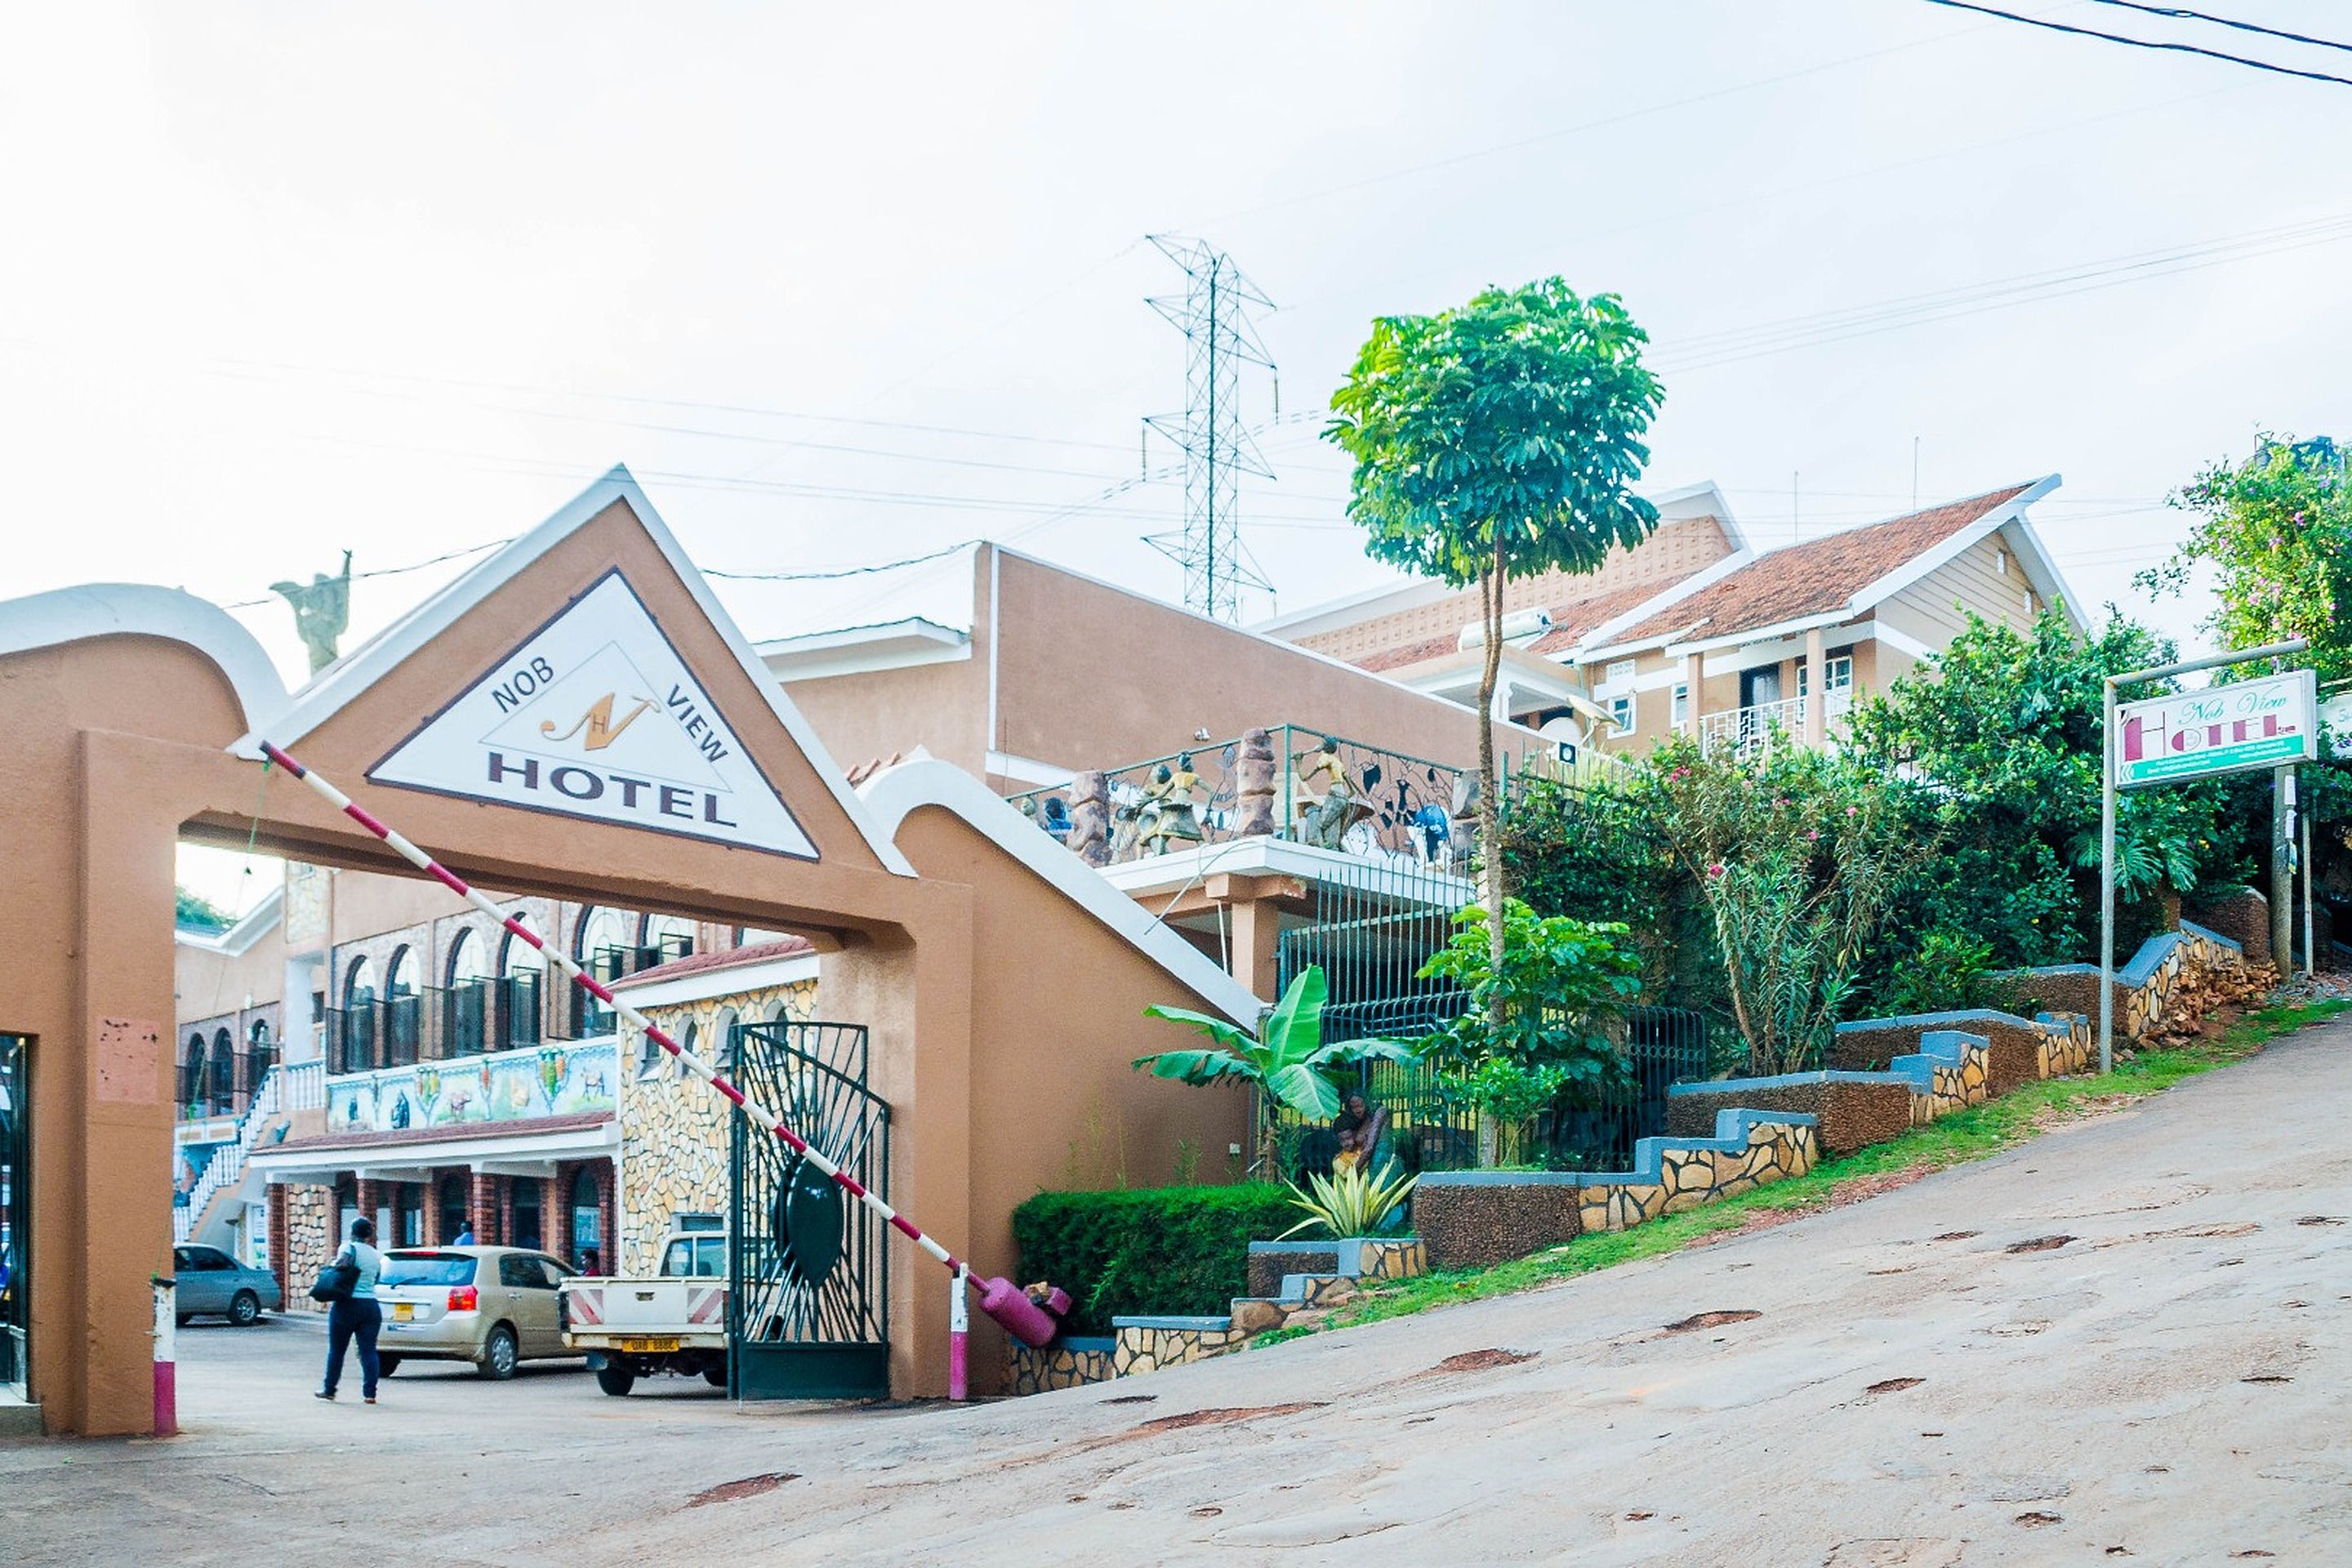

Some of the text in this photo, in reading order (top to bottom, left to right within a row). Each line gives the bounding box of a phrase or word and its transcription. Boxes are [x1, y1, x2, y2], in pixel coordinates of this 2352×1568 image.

[492, 657, 555, 714] NOB
[2178, 684, 2289, 725] Nob View
[666, 684, 729, 764] VIEW
[488, 751, 737, 828] HOTEL
